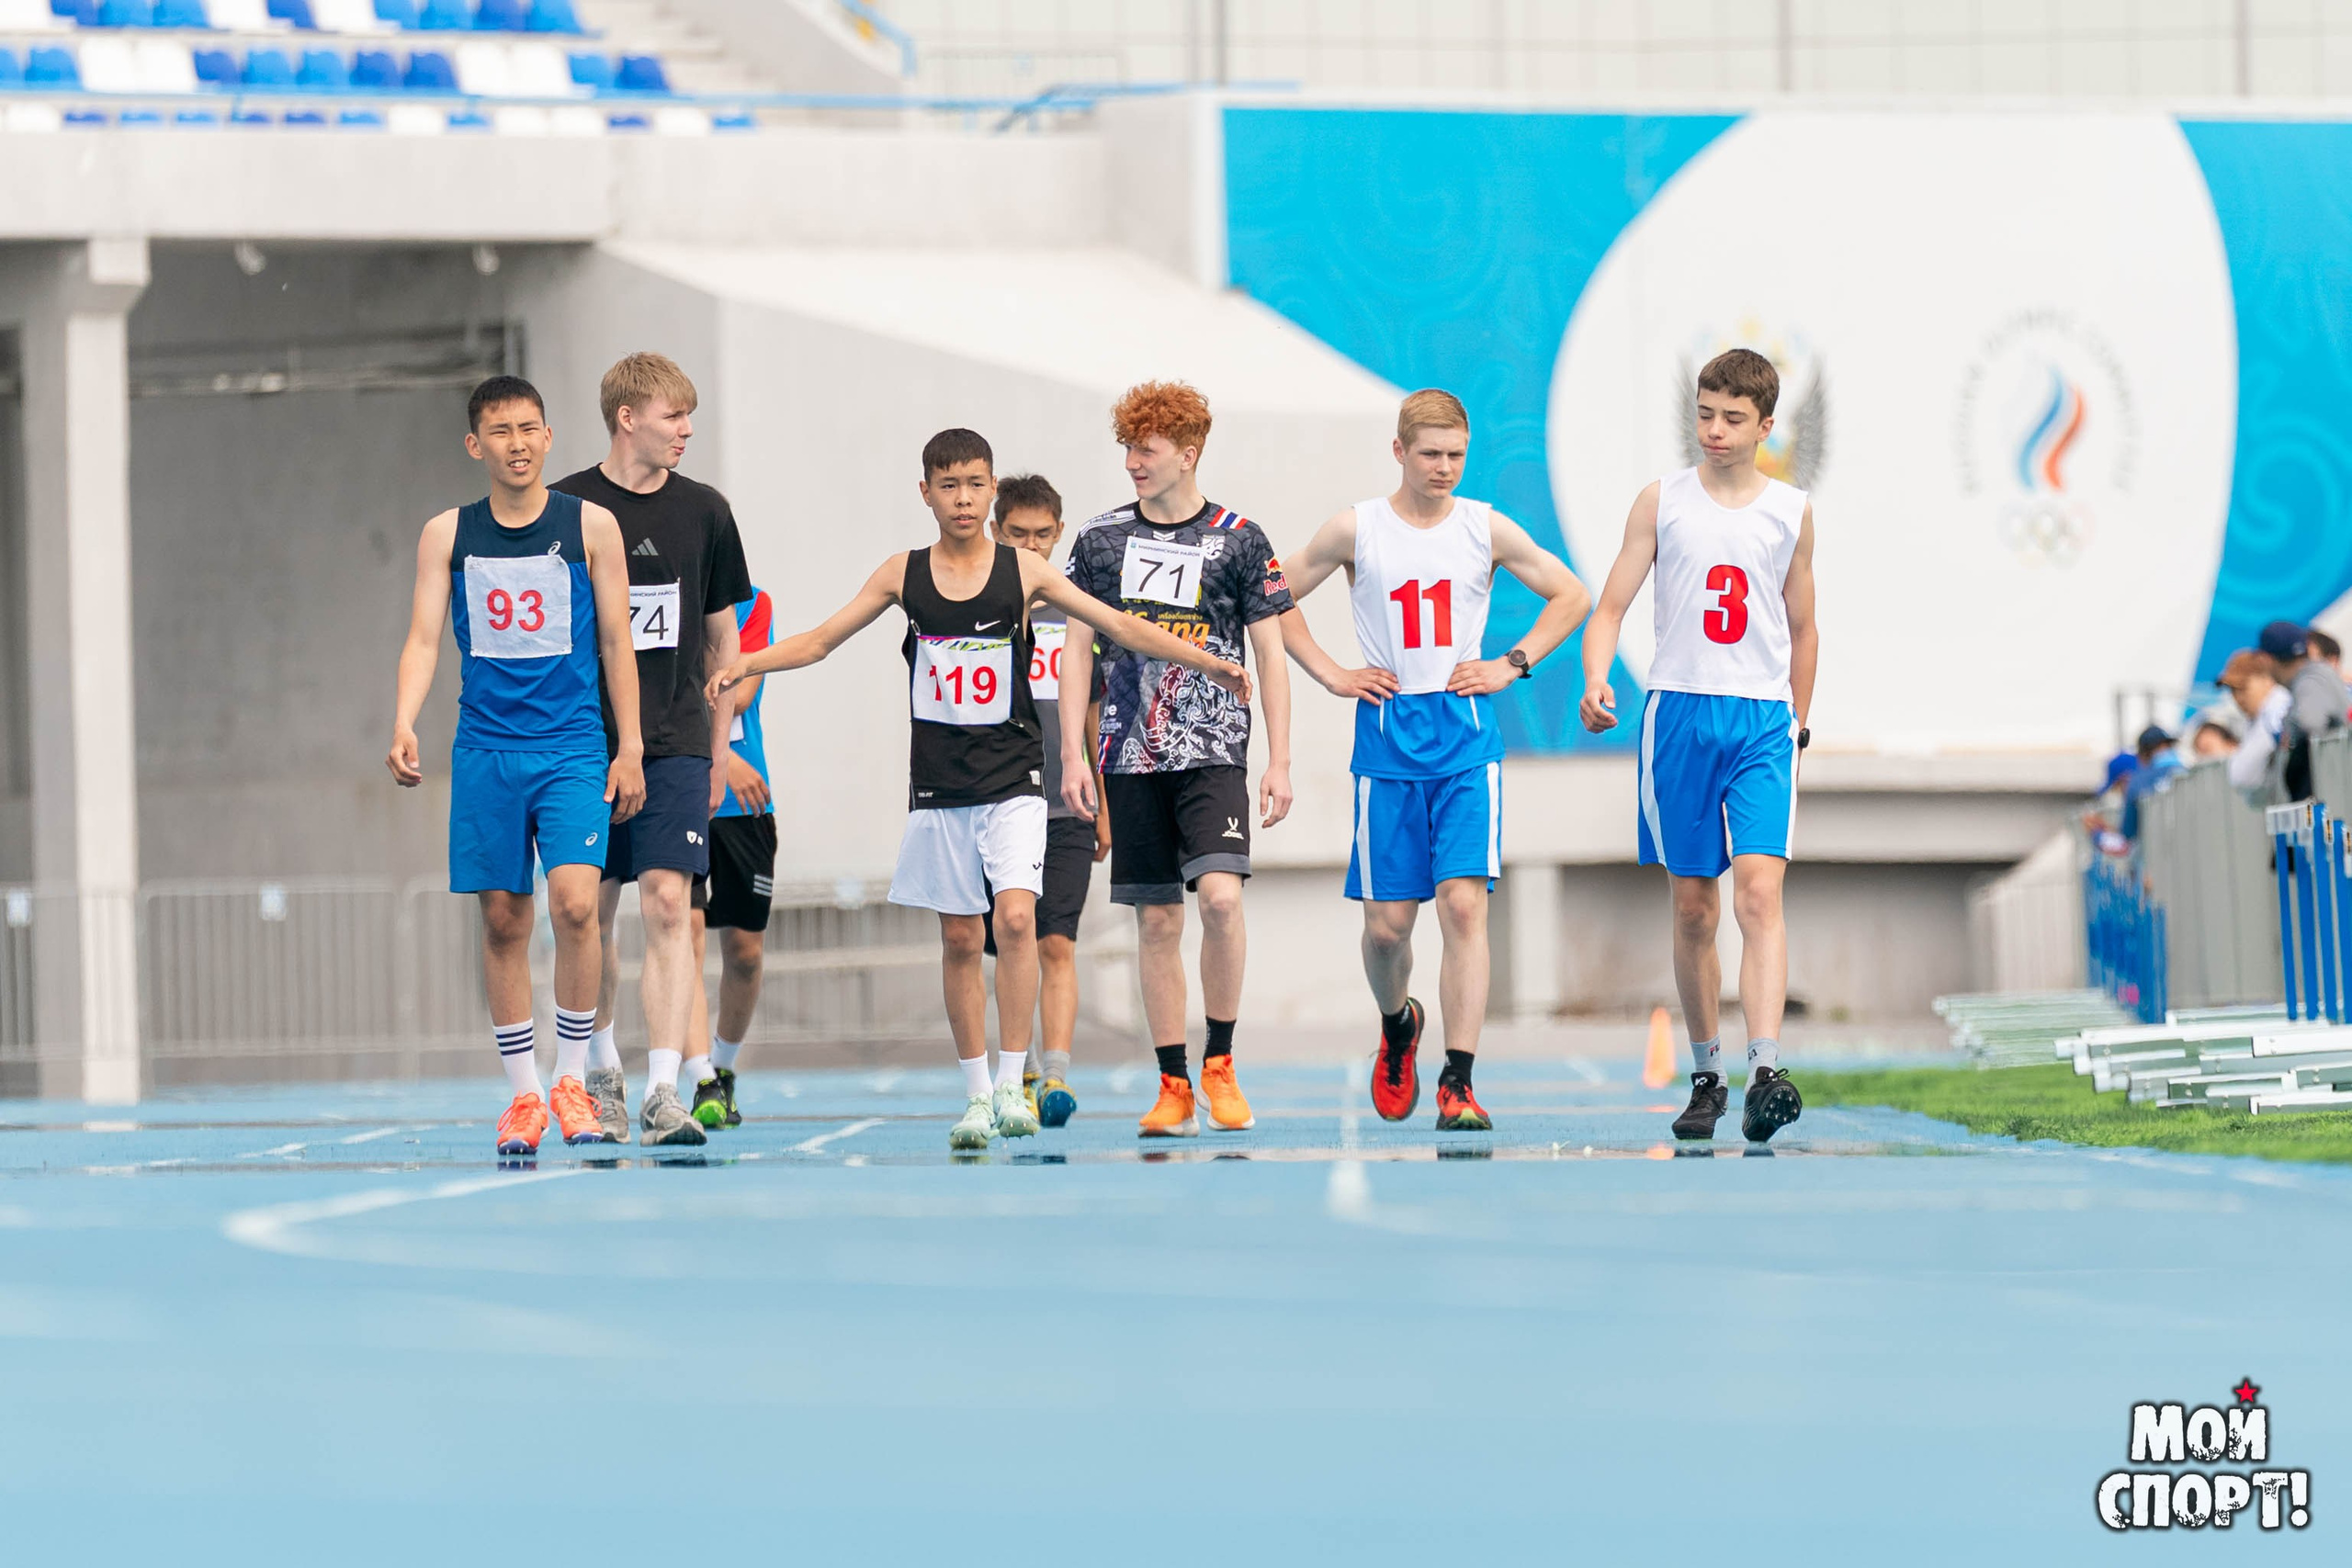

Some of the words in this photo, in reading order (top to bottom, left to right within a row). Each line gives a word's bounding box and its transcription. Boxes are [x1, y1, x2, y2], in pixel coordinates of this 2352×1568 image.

[1138, 558, 1185, 599] 71
[1263, 573, 1289, 596] Red
[486, 588, 546, 633] 93
[1389, 579, 1453, 649] 11
[1702, 564, 1749, 645] 3
[929, 664, 998, 705] 119
